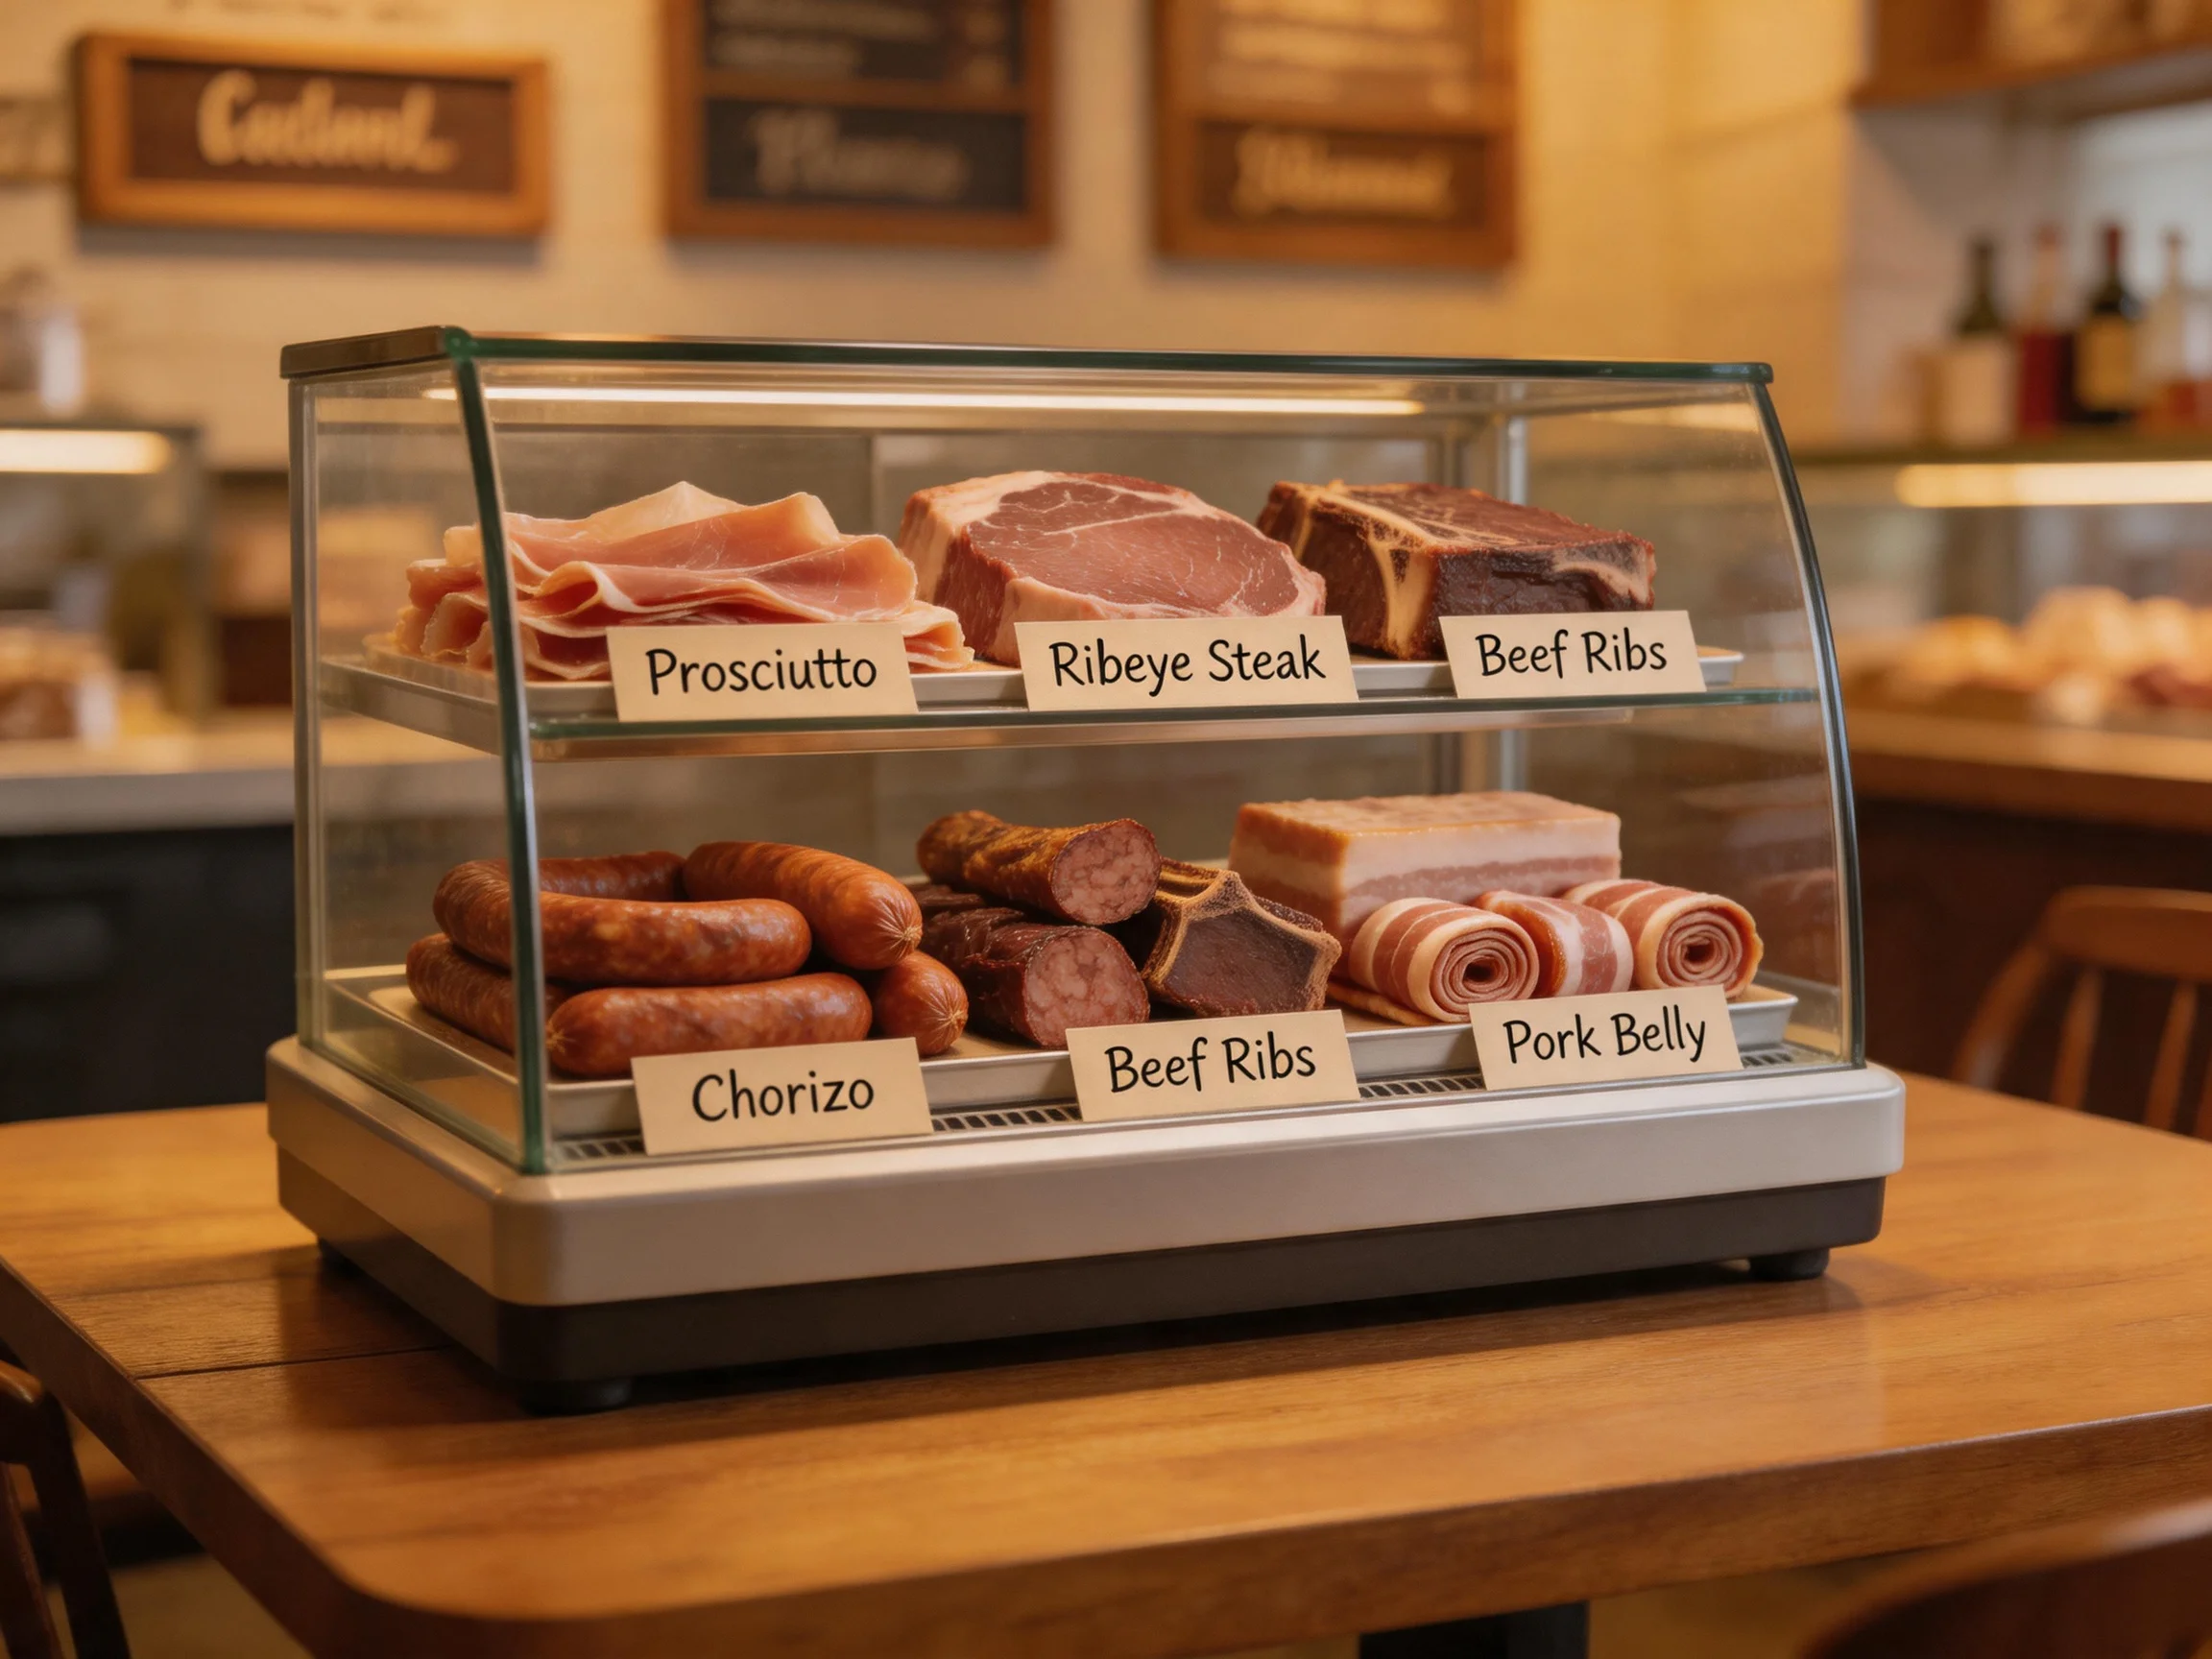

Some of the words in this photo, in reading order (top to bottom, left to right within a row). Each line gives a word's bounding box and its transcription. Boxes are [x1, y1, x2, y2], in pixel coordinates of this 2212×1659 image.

[644, 648, 878, 696] Prosciutto
[1048, 637, 1193, 698] Ribeye
[1208, 633, 1327, 683] Steak
[1475, 628, 1569, 680] Beef
[1580, 626, 1668, 674] Ribs
[1103, 1036, 1209, 1094] Beef
[1220, 1030, 1316, 1084] Ribs
[1502, 1013, 1602, 1065] Pork
[1610, 1003, 1706, 1063] Belly
[691, 1068, 875, 1122] Chorizo
